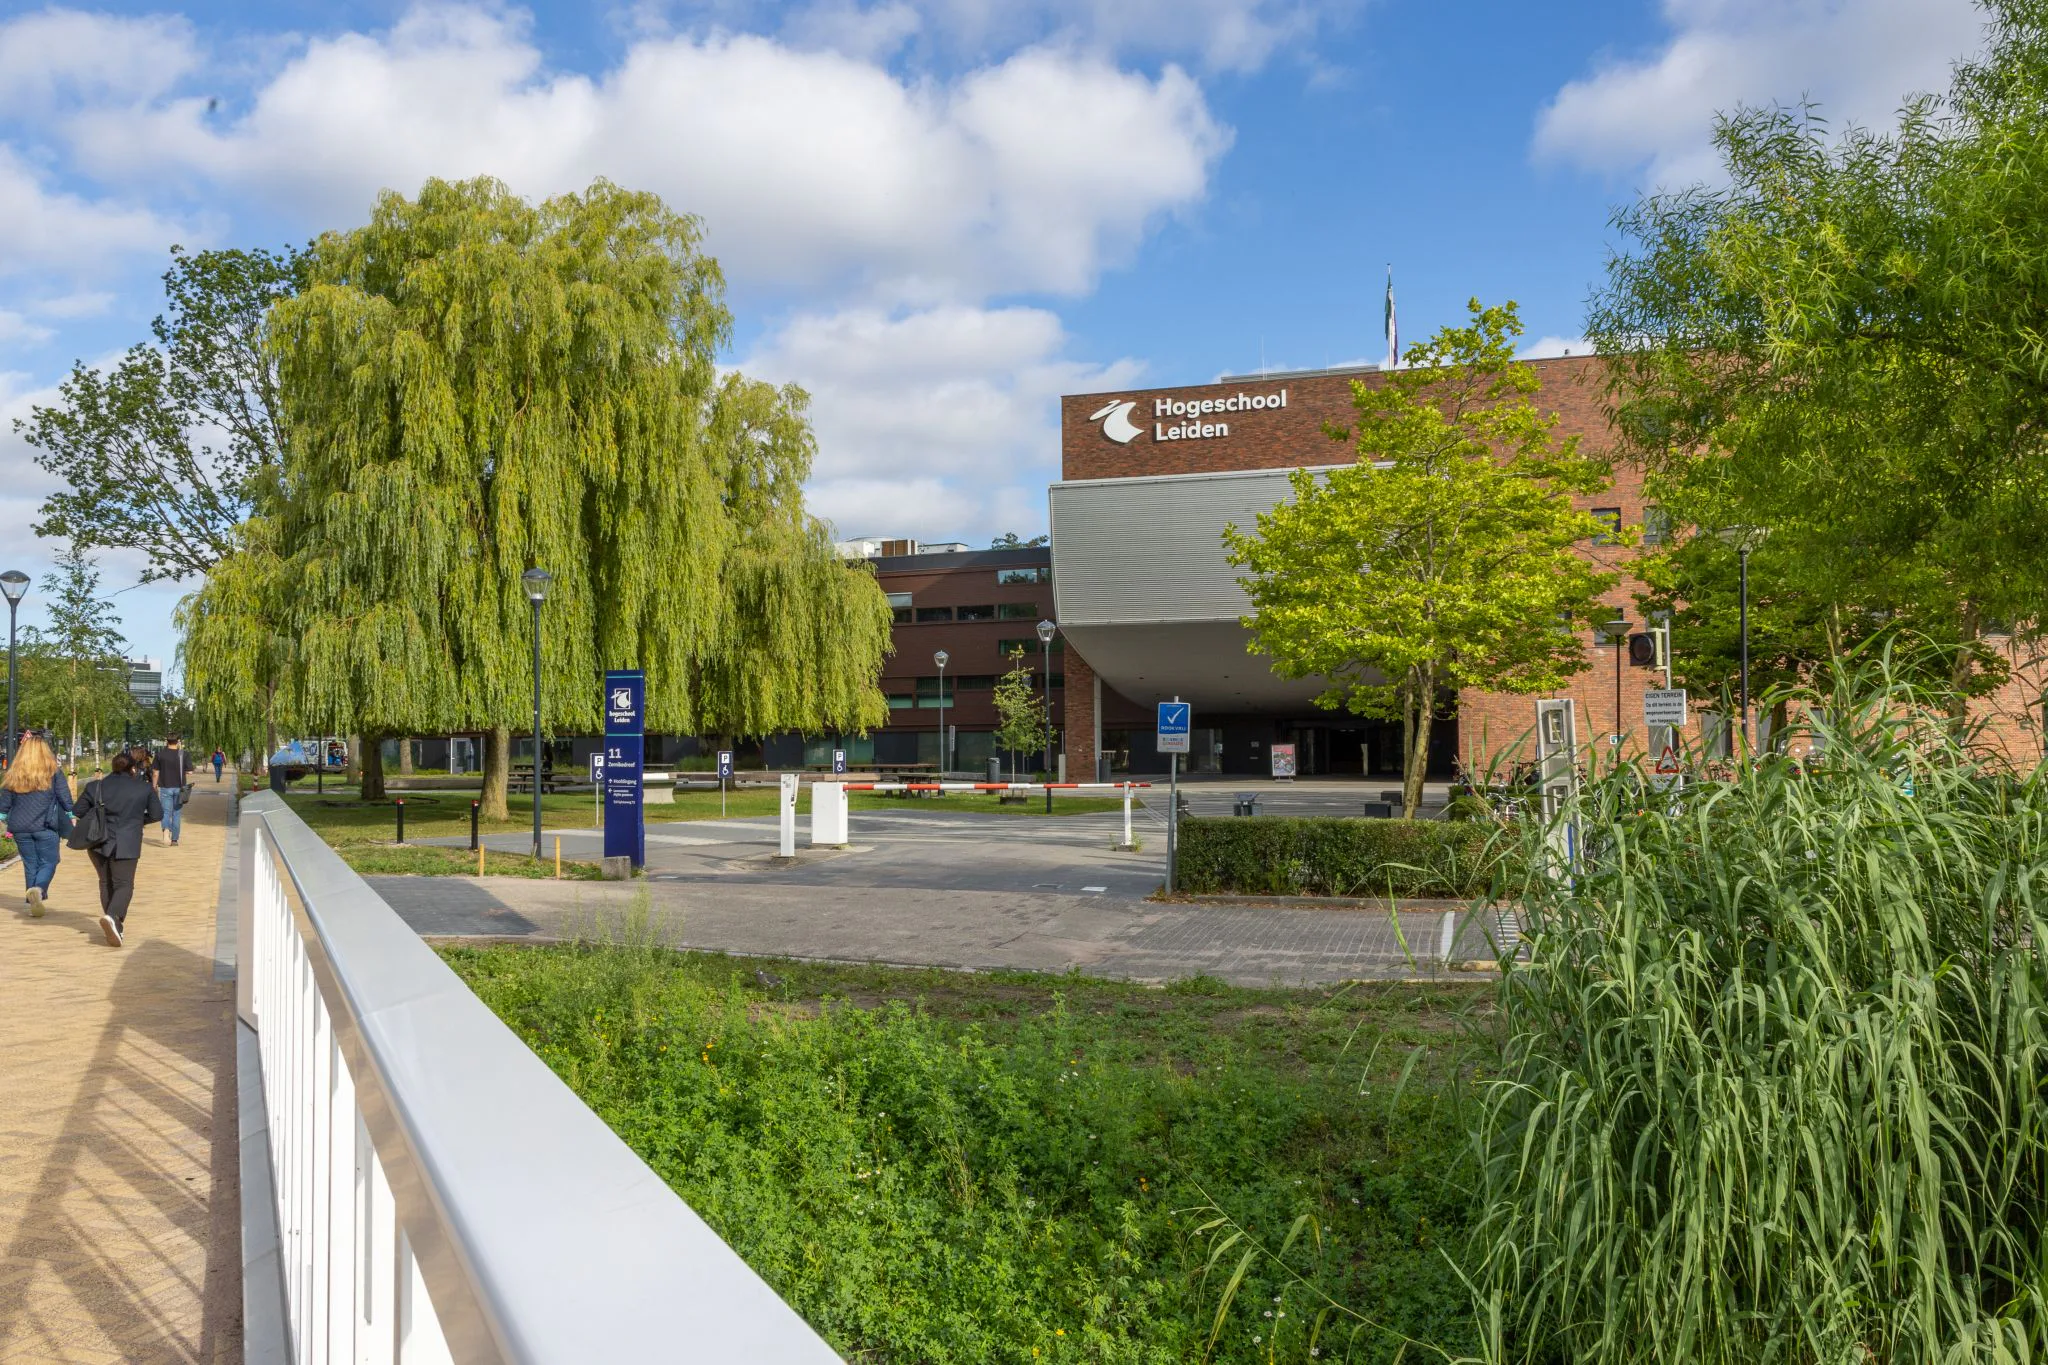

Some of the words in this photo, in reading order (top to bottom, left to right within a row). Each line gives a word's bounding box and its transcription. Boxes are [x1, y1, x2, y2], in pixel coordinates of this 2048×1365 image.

[1155, 389, 1287, 419] Hogeschool
[1155, 420, 1229, 441] Leiden
[608, 748, 622, 759] 11
